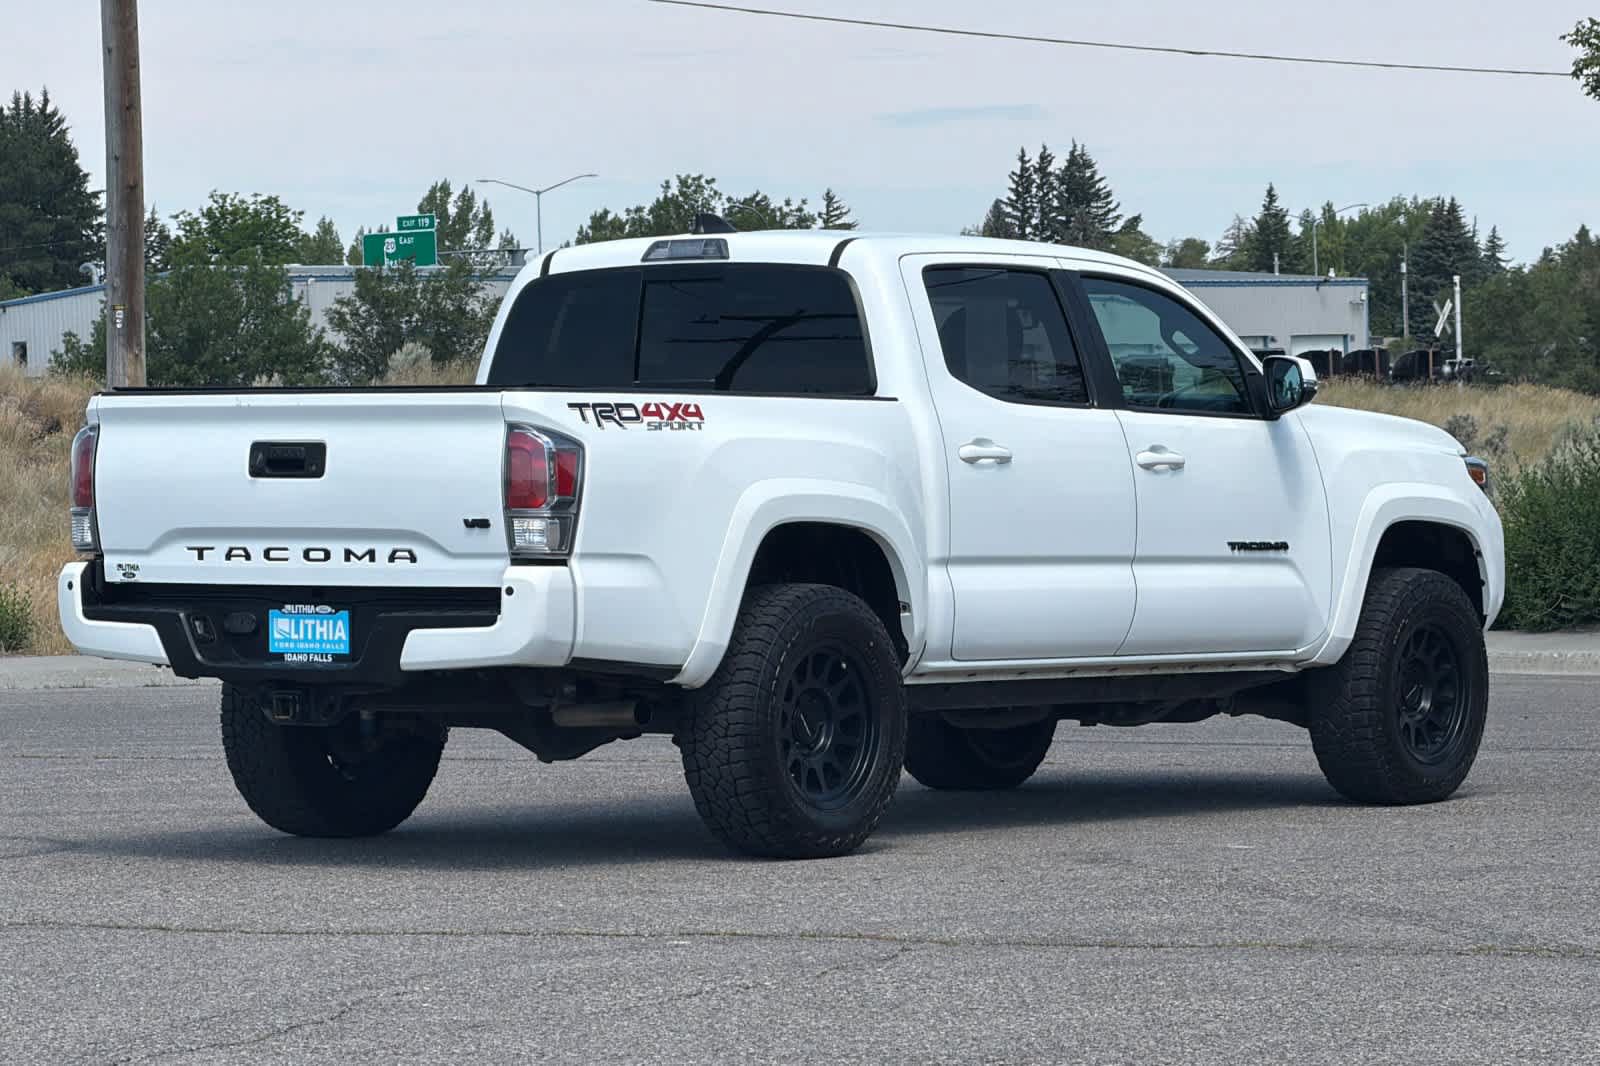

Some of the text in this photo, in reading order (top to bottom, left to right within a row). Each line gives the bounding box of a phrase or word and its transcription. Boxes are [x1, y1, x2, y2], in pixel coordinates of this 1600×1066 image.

[418, 217, 430, 228] 119
[567, 402, 643, 430] TRD
[647, 421, 705, 431] SPORT
[1227, 541, 1289, 552] TACOMA
[187, 547, 418, 564] TACOMA
[291, 604, 315, 614] LITHIA
[291, 619, 346, 641] LITHIA
[322, 642, 345, 650] FALLS
[284, 653, 333, 662] IDAHO FALLS
